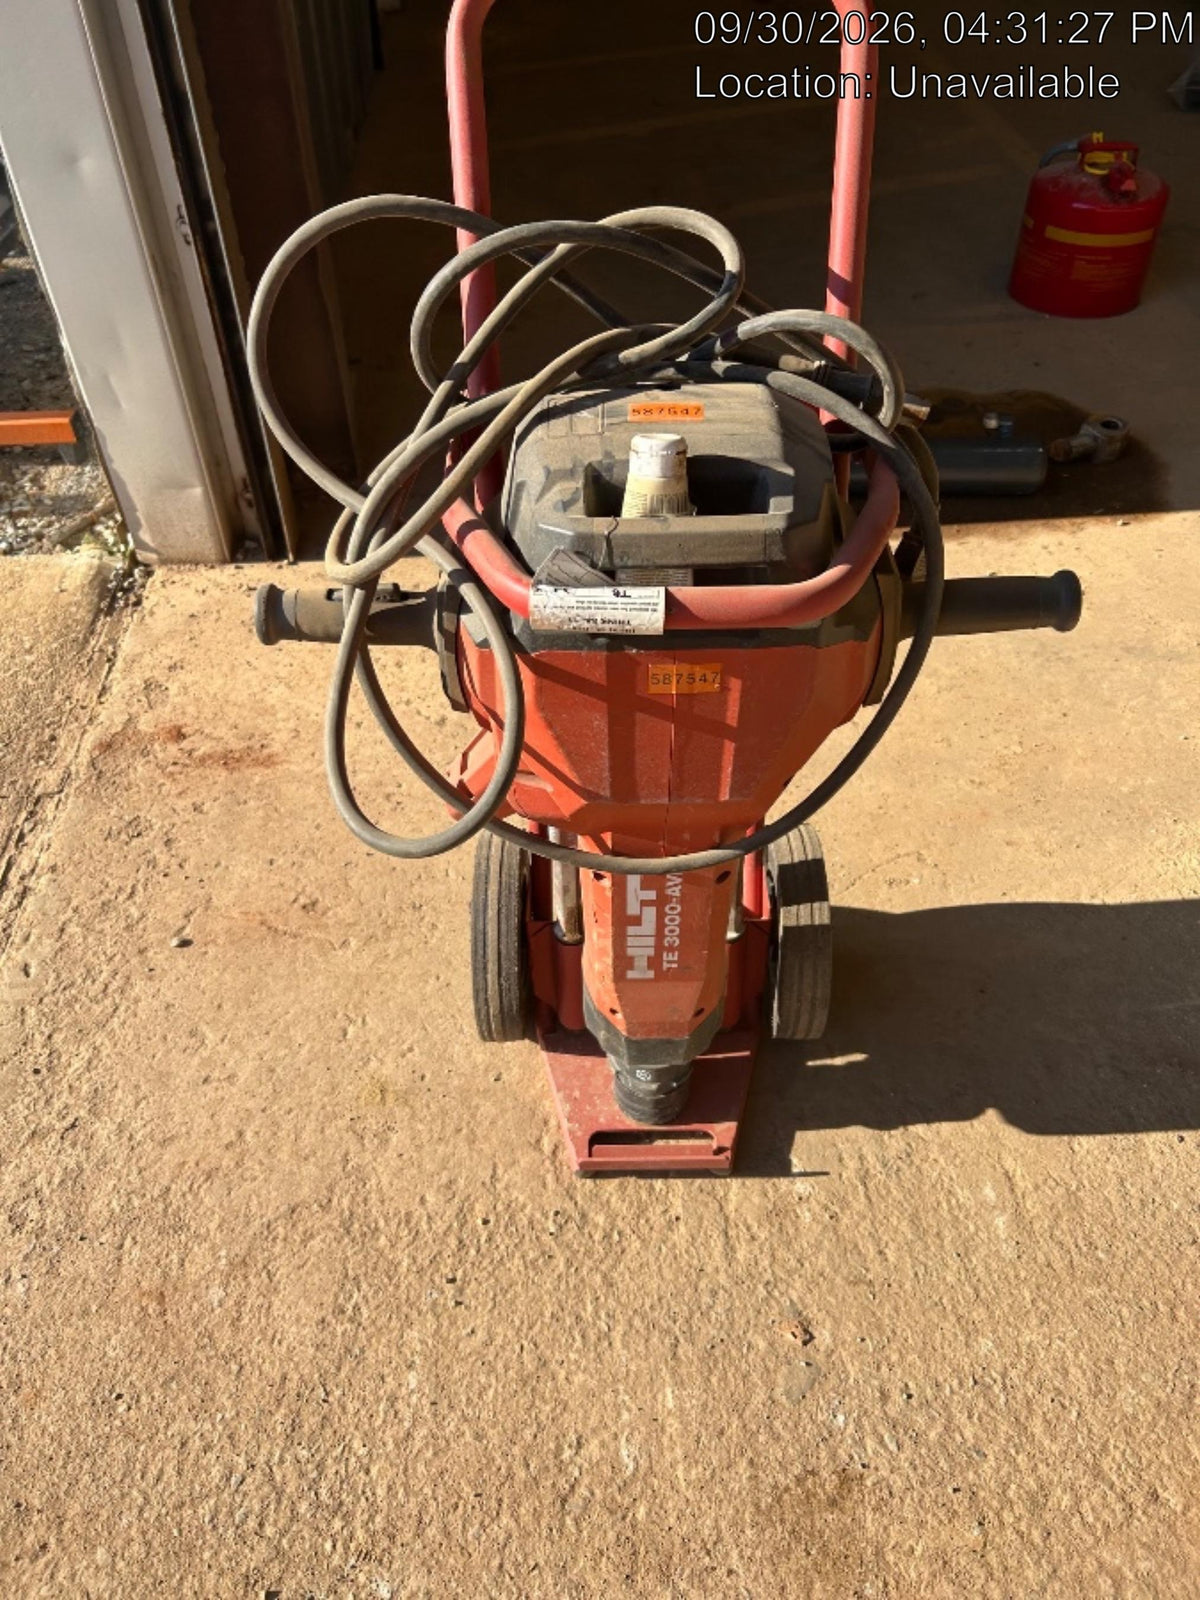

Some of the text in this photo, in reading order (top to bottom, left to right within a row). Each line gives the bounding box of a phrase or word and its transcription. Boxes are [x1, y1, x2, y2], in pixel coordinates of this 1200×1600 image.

[651, 671, 719, 685] 587547
[626, 873, 657, 979] HILT
[662, 871, 683, 971] TE 3000-AV
